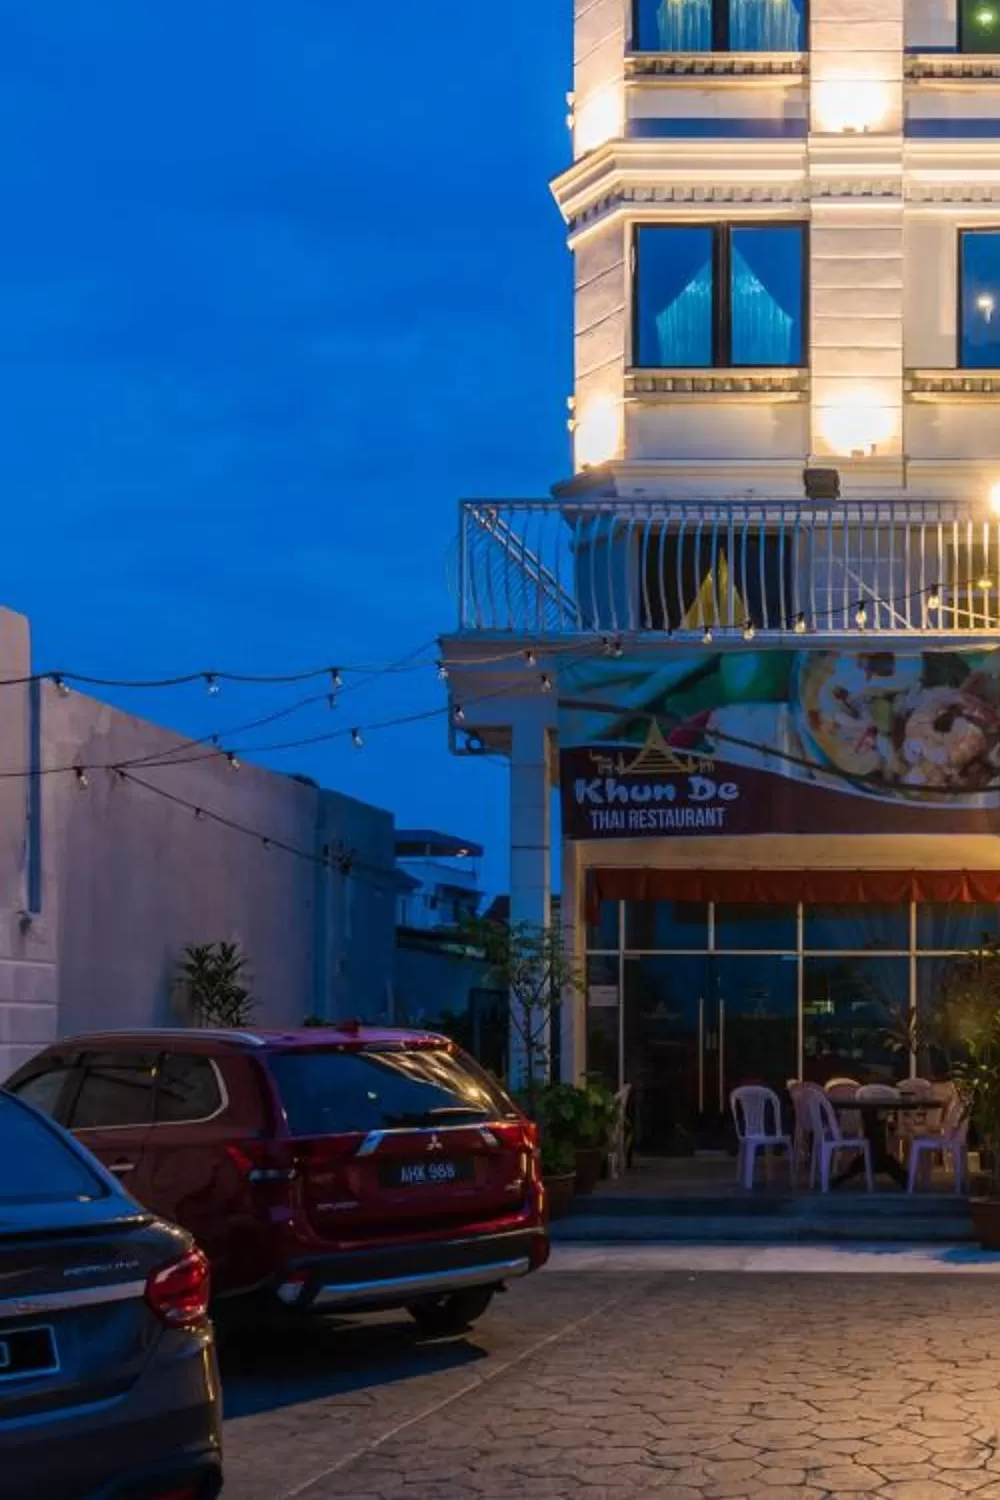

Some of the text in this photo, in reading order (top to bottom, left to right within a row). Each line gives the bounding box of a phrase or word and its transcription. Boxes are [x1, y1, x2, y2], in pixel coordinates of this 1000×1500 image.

[574, 776, 740, 804] Khun De
[590, 807, 726, 830] THAI RESTAURANT
